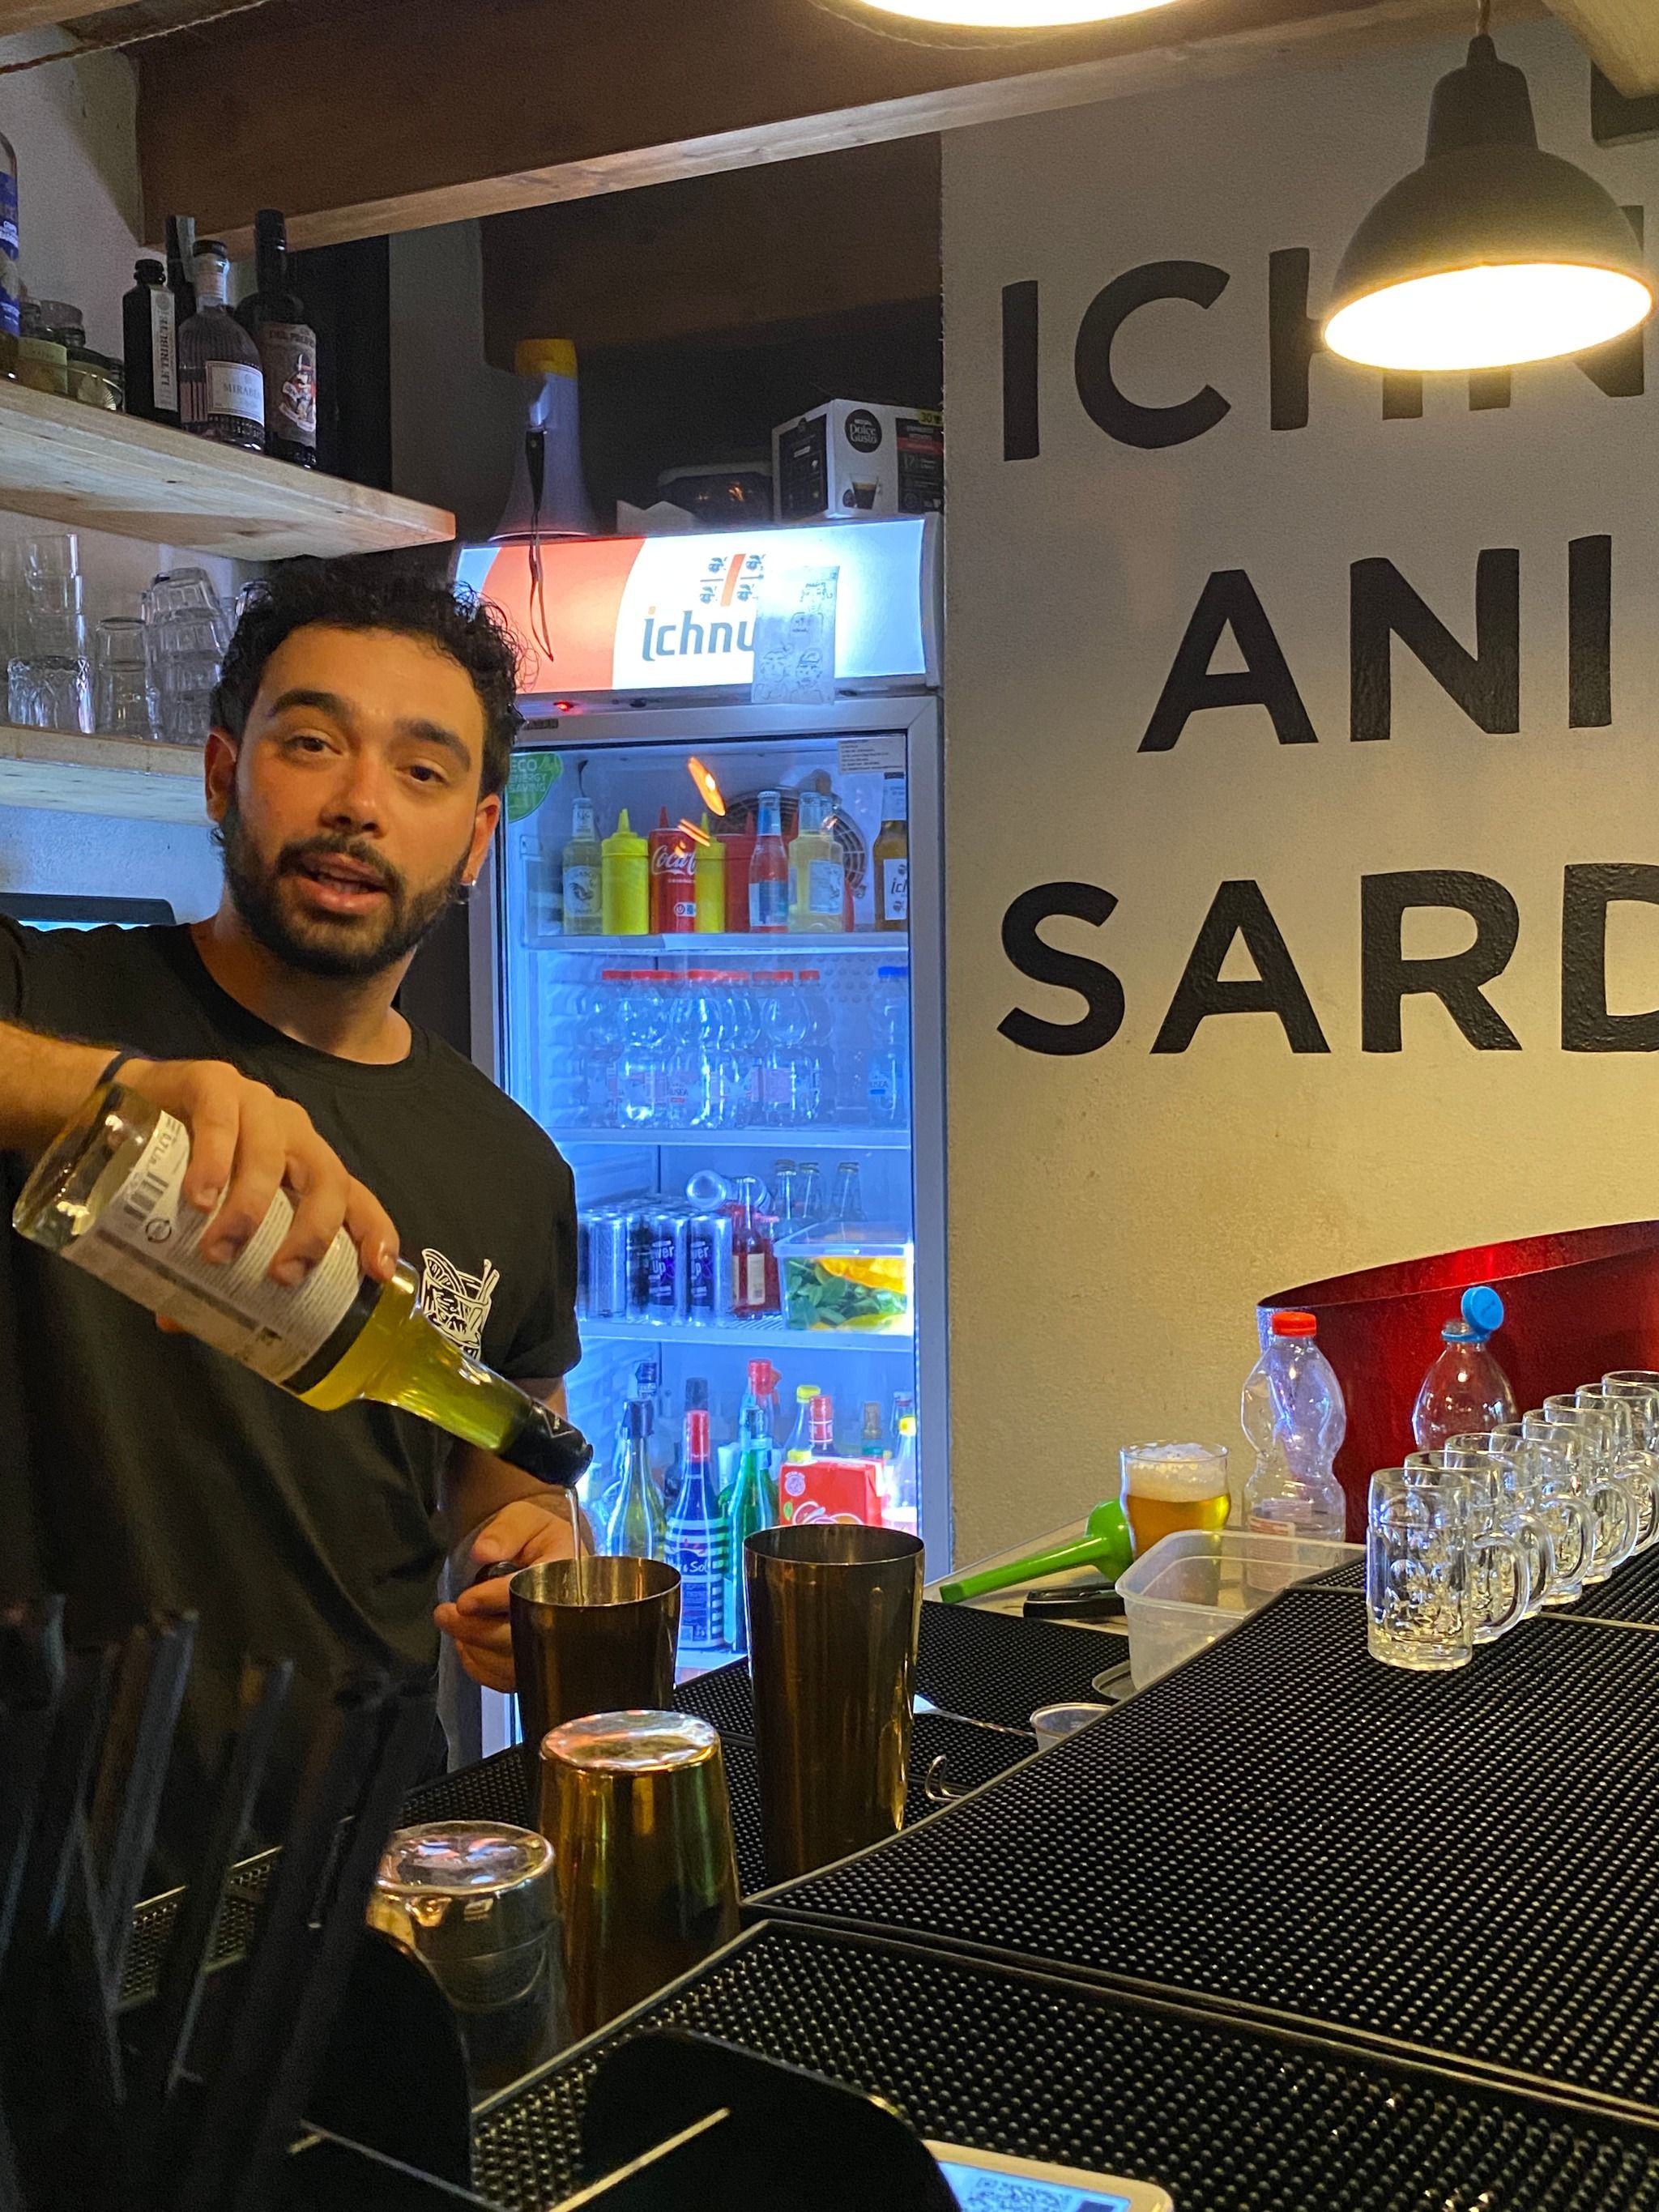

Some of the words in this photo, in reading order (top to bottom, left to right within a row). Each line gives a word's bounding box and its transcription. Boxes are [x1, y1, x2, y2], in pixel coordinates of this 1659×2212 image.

[1002, 205, 1644, 462] ICH
[850, 423, 876, 436] Dolce
[850, 433, 877, 445] Gusto
[1137, 534, 1612, 752] ANI
